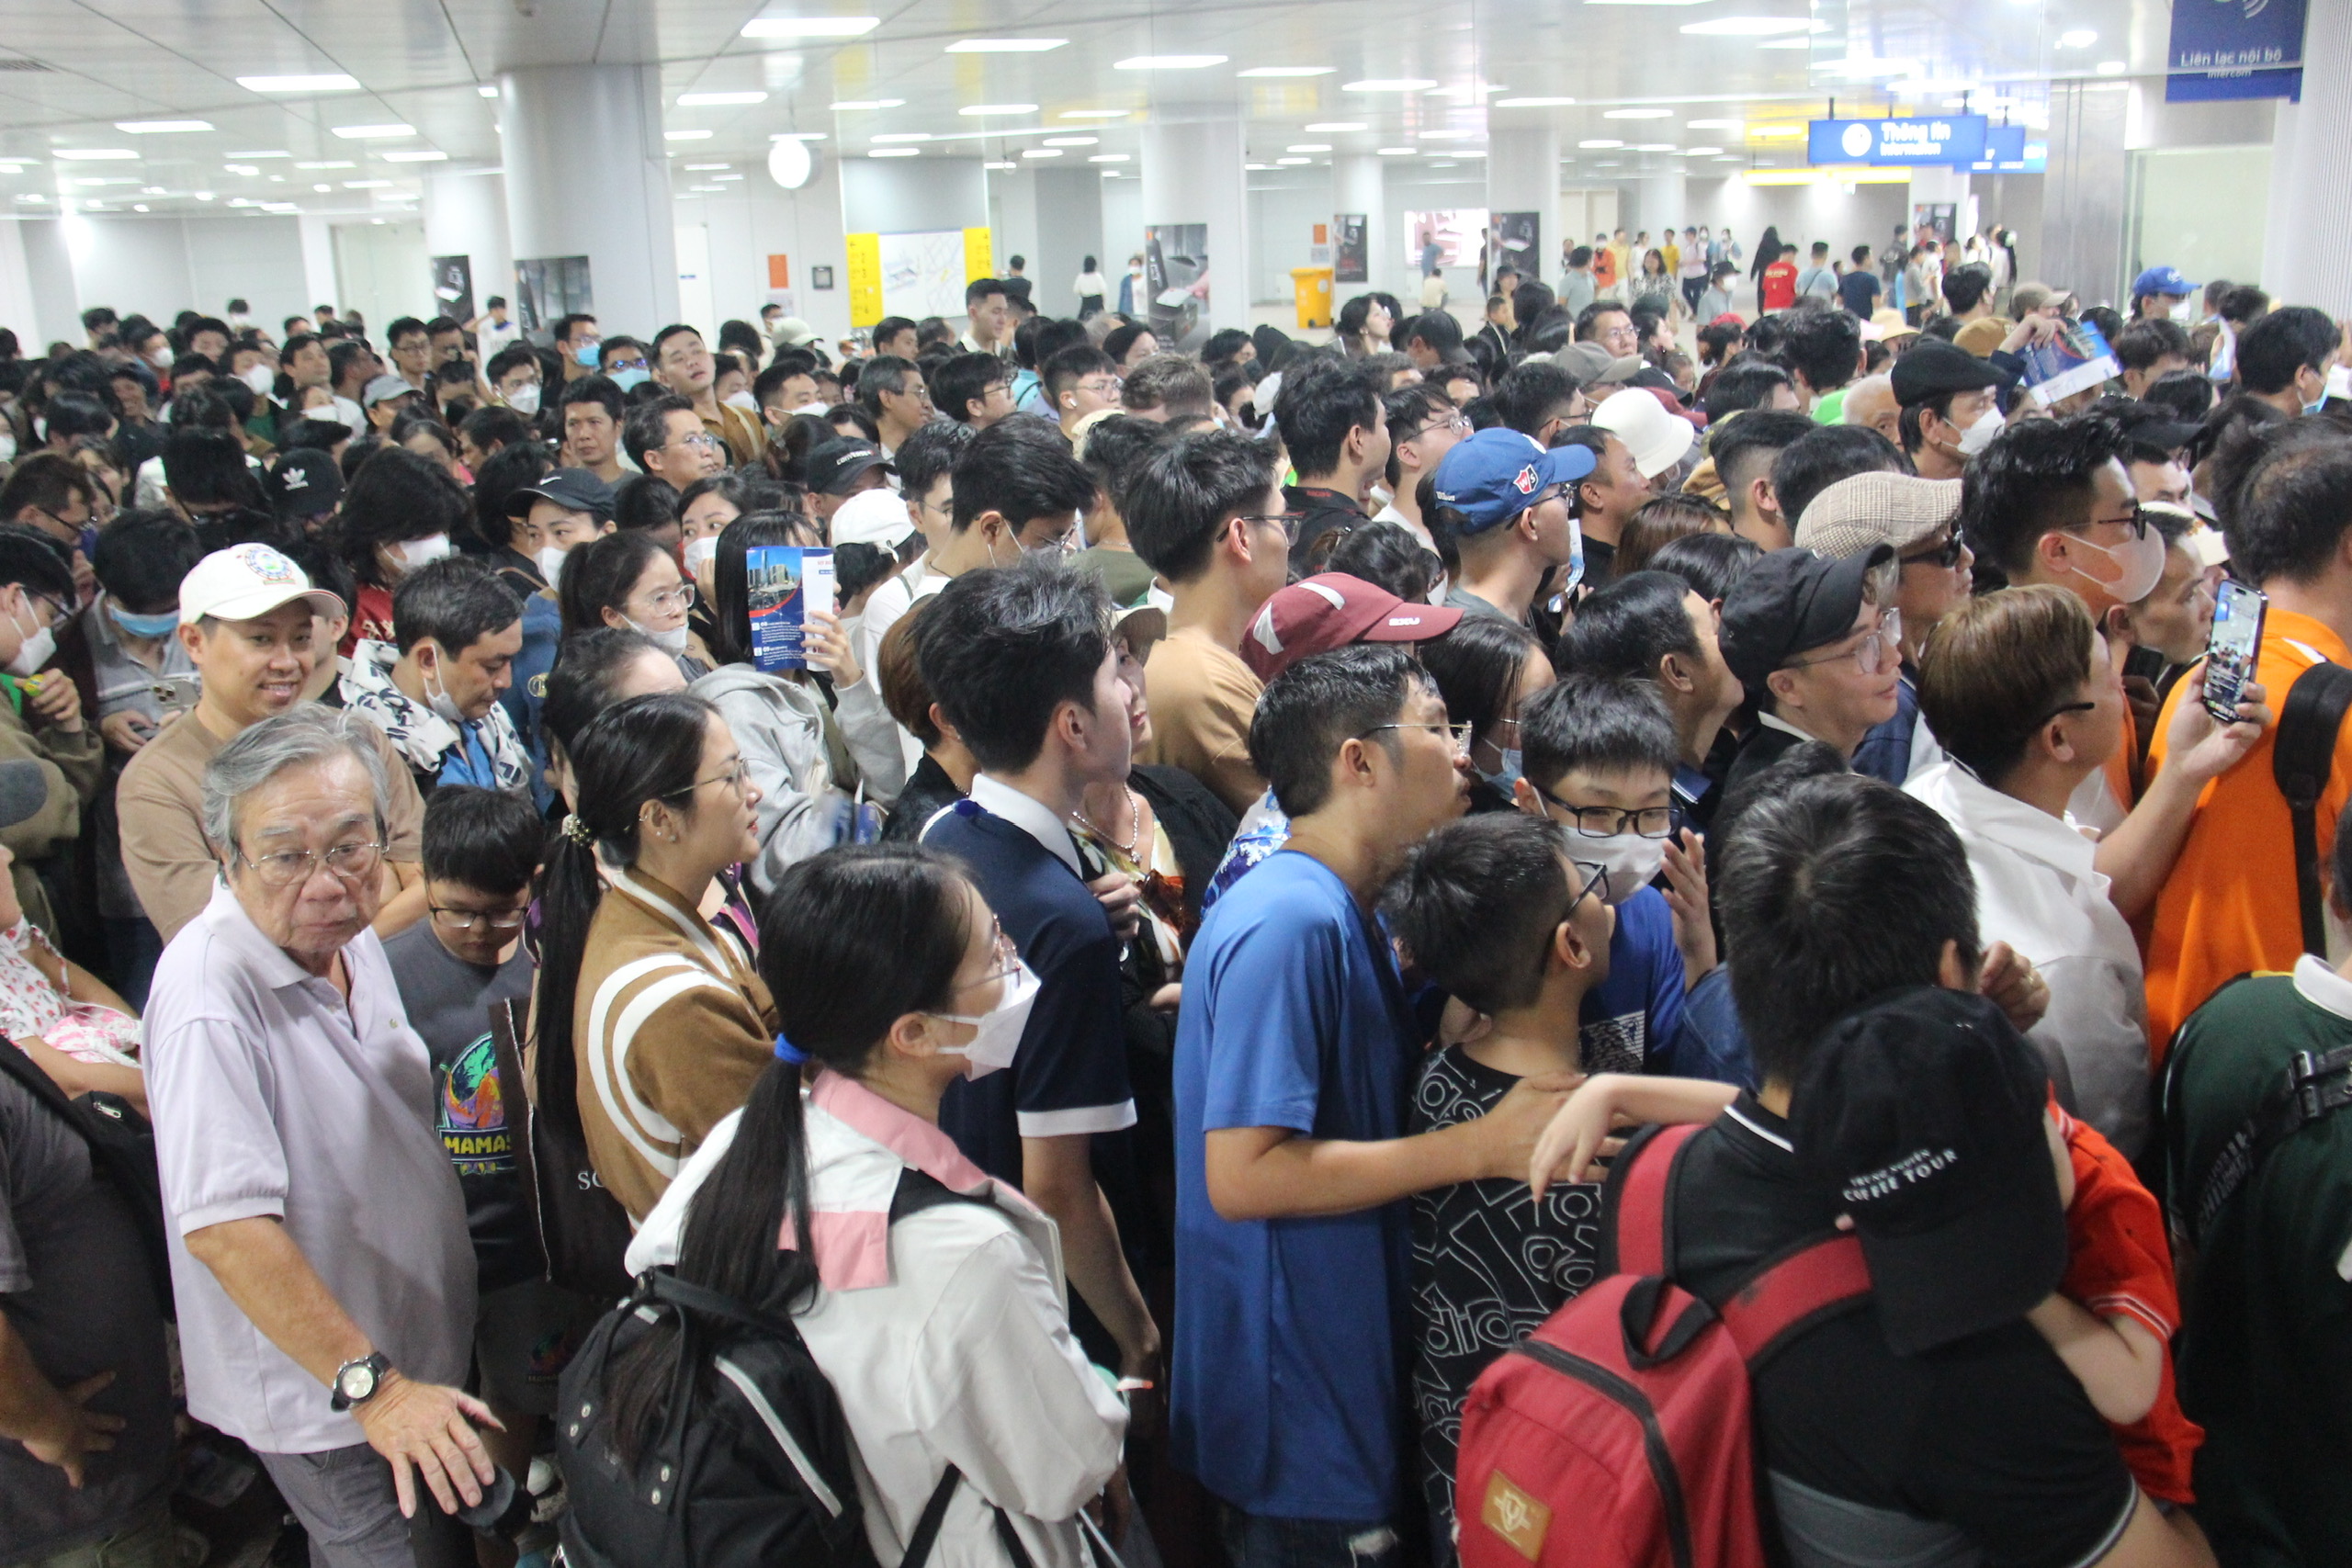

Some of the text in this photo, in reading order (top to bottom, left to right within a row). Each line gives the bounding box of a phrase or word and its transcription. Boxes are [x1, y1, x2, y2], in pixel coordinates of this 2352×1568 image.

[2180, 46, 2282, 68] Liên lạc nội bộ
[1843, 1148, 1958, 1202] COFFEE TOUR
